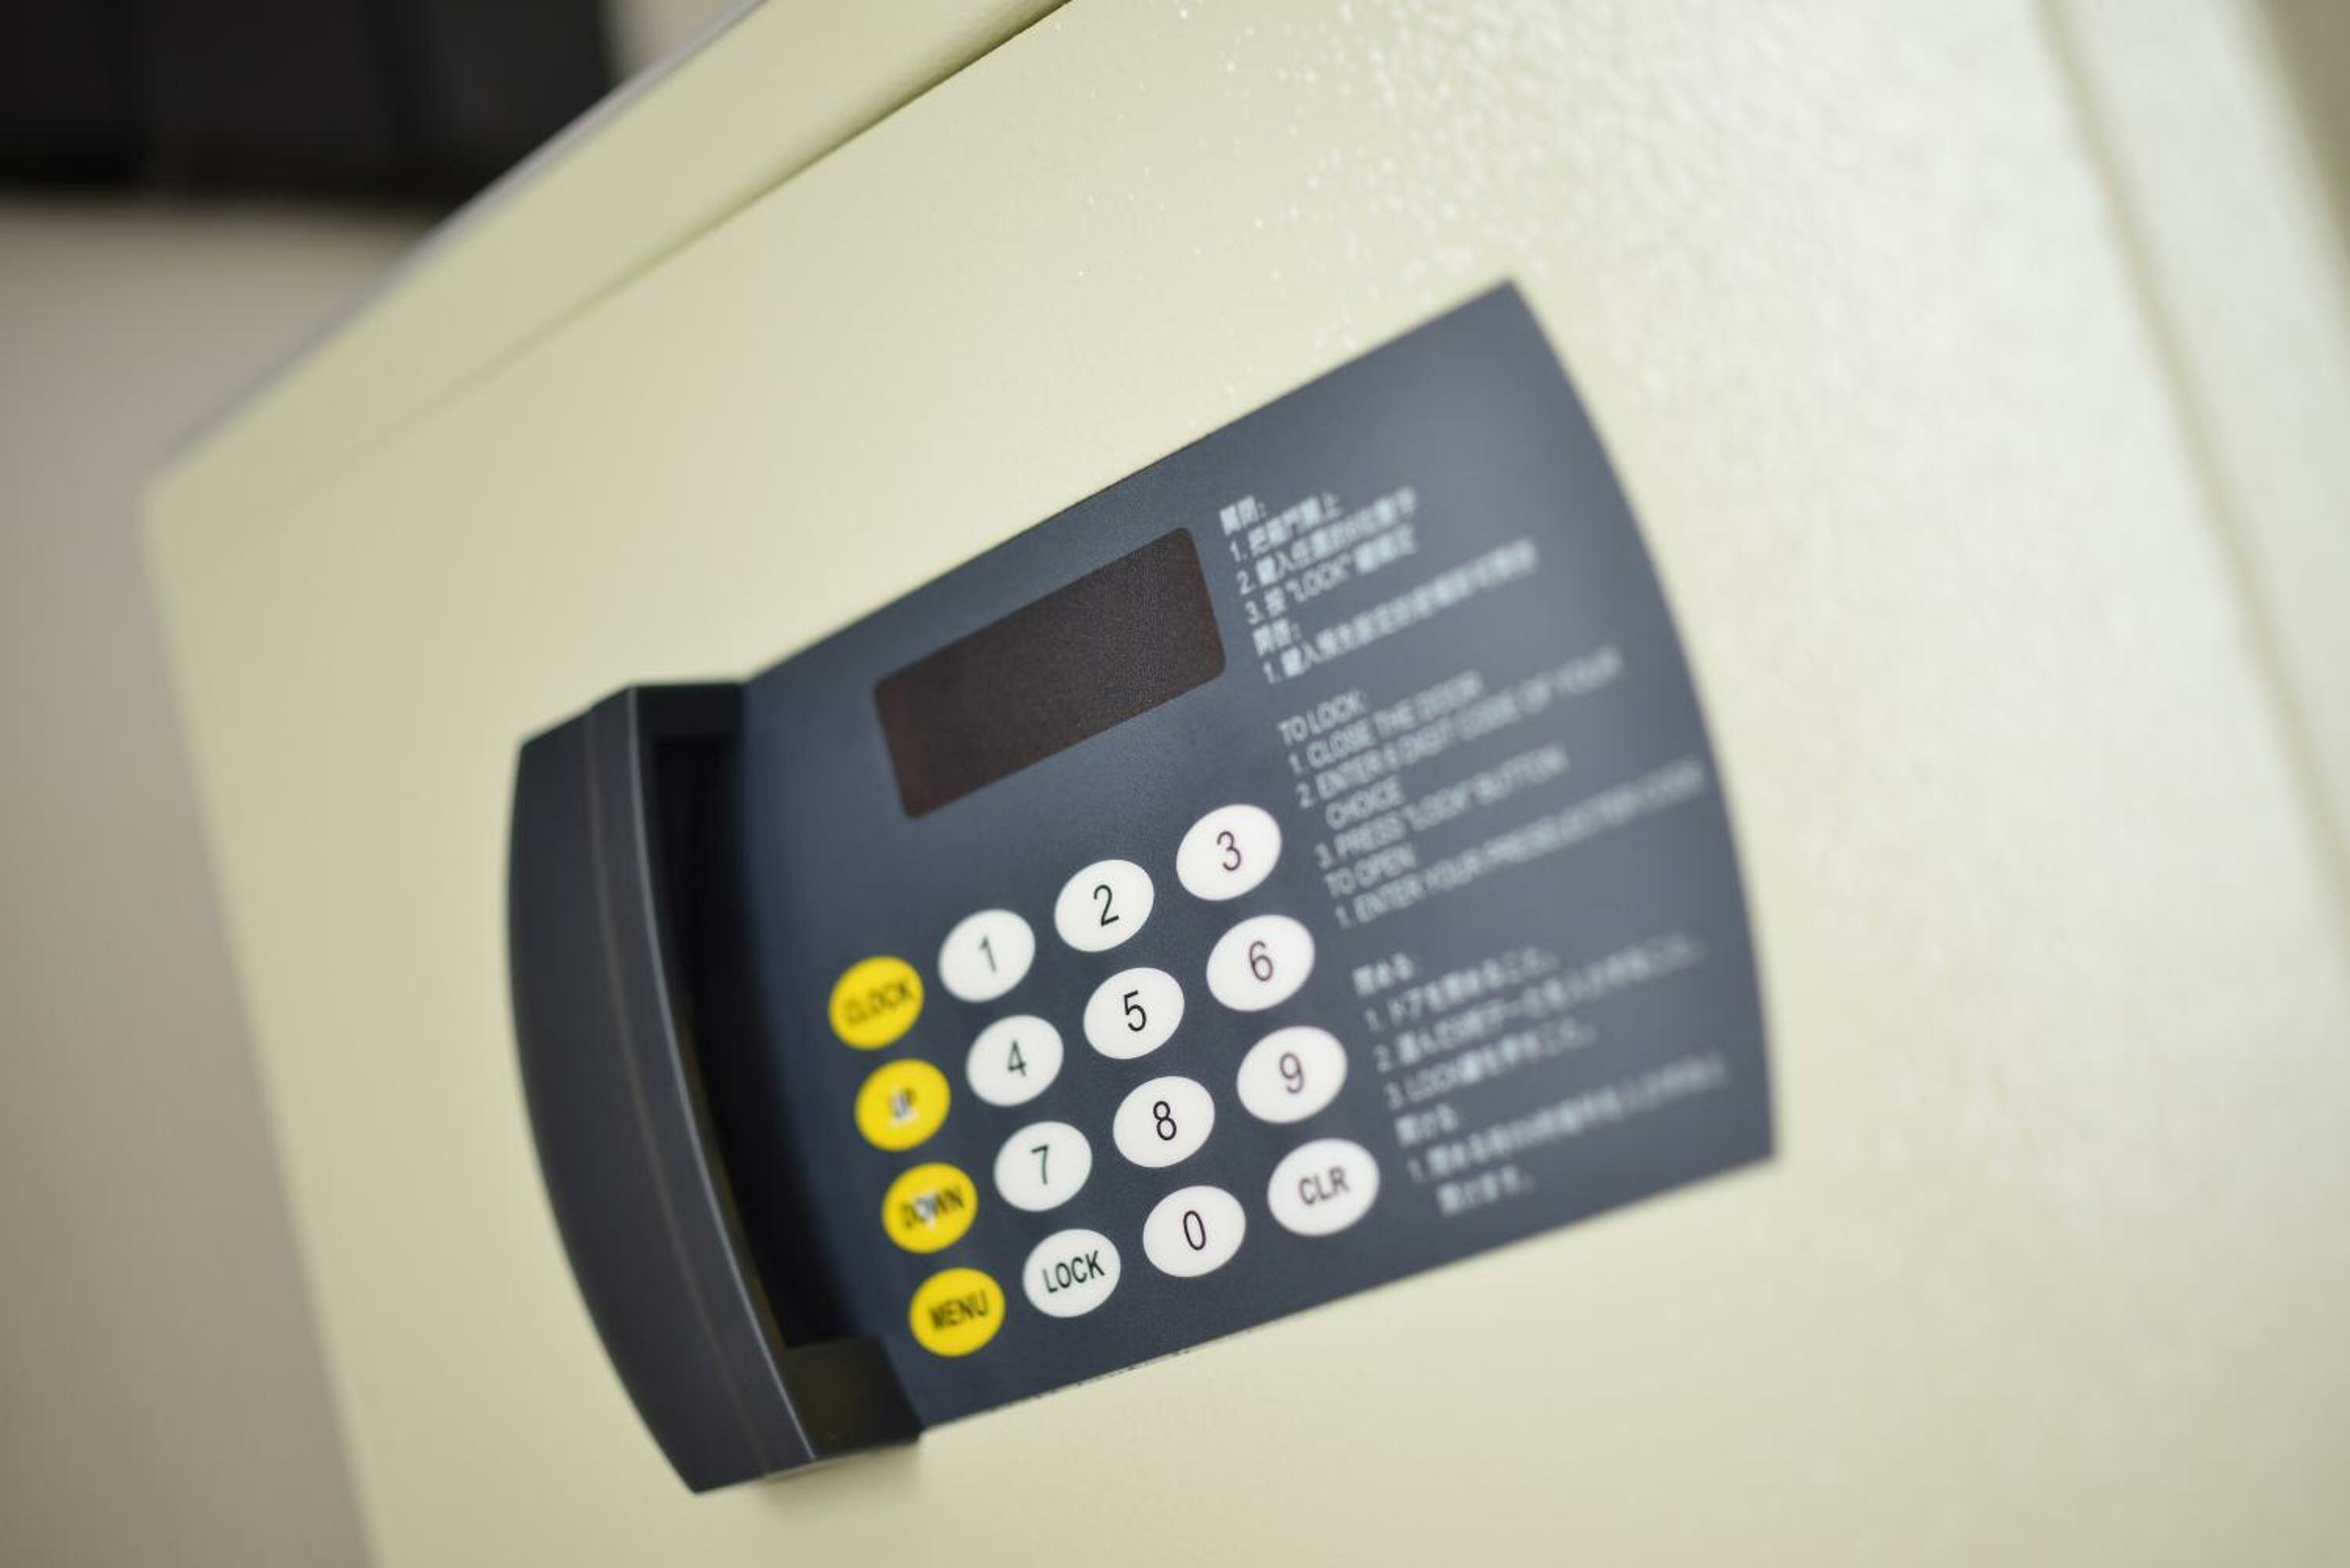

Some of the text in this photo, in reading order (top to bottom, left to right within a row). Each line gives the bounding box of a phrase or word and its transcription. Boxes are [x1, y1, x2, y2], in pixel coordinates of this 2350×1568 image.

[1278, 714, 1307, 745] TO
[1306, 718, 1375, 768] CLOSE
[1372, 698, 1415, 739] THE
[1314, 750, 1384, 800] ENTER
[1325, 774, 1406, 829] CHOICE
[1217, 830, 1242, 872] 3
[1324, 866, 1356, 898] TO
[1352, 873, 1428, 924] ENTER
[1093, 884, 1119, 927] 2
[979, 937, 997, 972] 1
[1249, 941, 1274, 982] 6
[844, 977, 915, 1026] CLOCK
[1123, 989, 1148, 1032] 5
[1007, 1041, 1027, 1077] 4
[1278, 1052, 1304, 1095] 9
[889, 1086, 916, 1121] UP
[1152, 1100, 1177, 1141] 8
[1031, 1144, 1050, 1185] 7
[1298, 1166, 1350, 1207] CLR
[900, 1186, 964, 1230] DOWN
[1183, 1210, 1207, 1252] 0
[1042, 1250, 1105, 1293] LOCK
[929, 1289, 989, 1330] MENU
